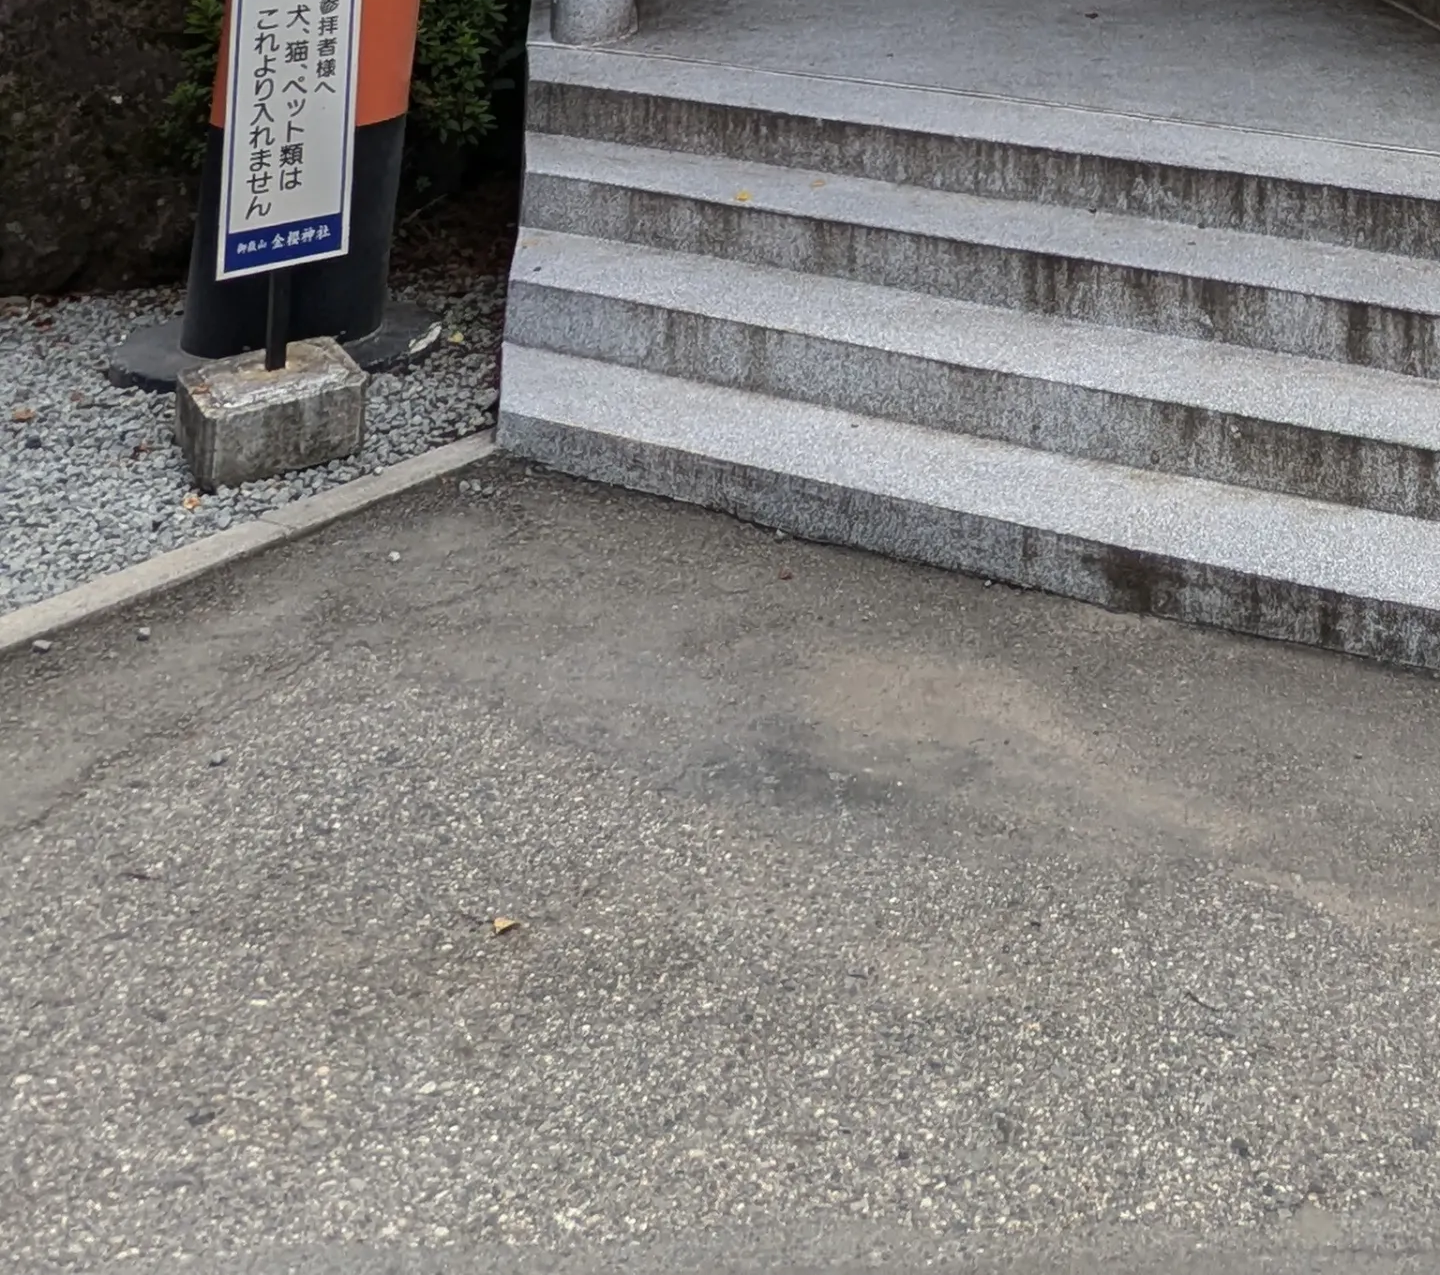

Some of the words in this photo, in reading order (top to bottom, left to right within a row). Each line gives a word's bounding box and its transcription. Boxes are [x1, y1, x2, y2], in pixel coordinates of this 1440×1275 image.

[245, 8, 280, 220] これより入れません
[279, 4, 311, 191] 犬、猫、ペット類は
[271, 225, 331, 249] 金櫻神社
